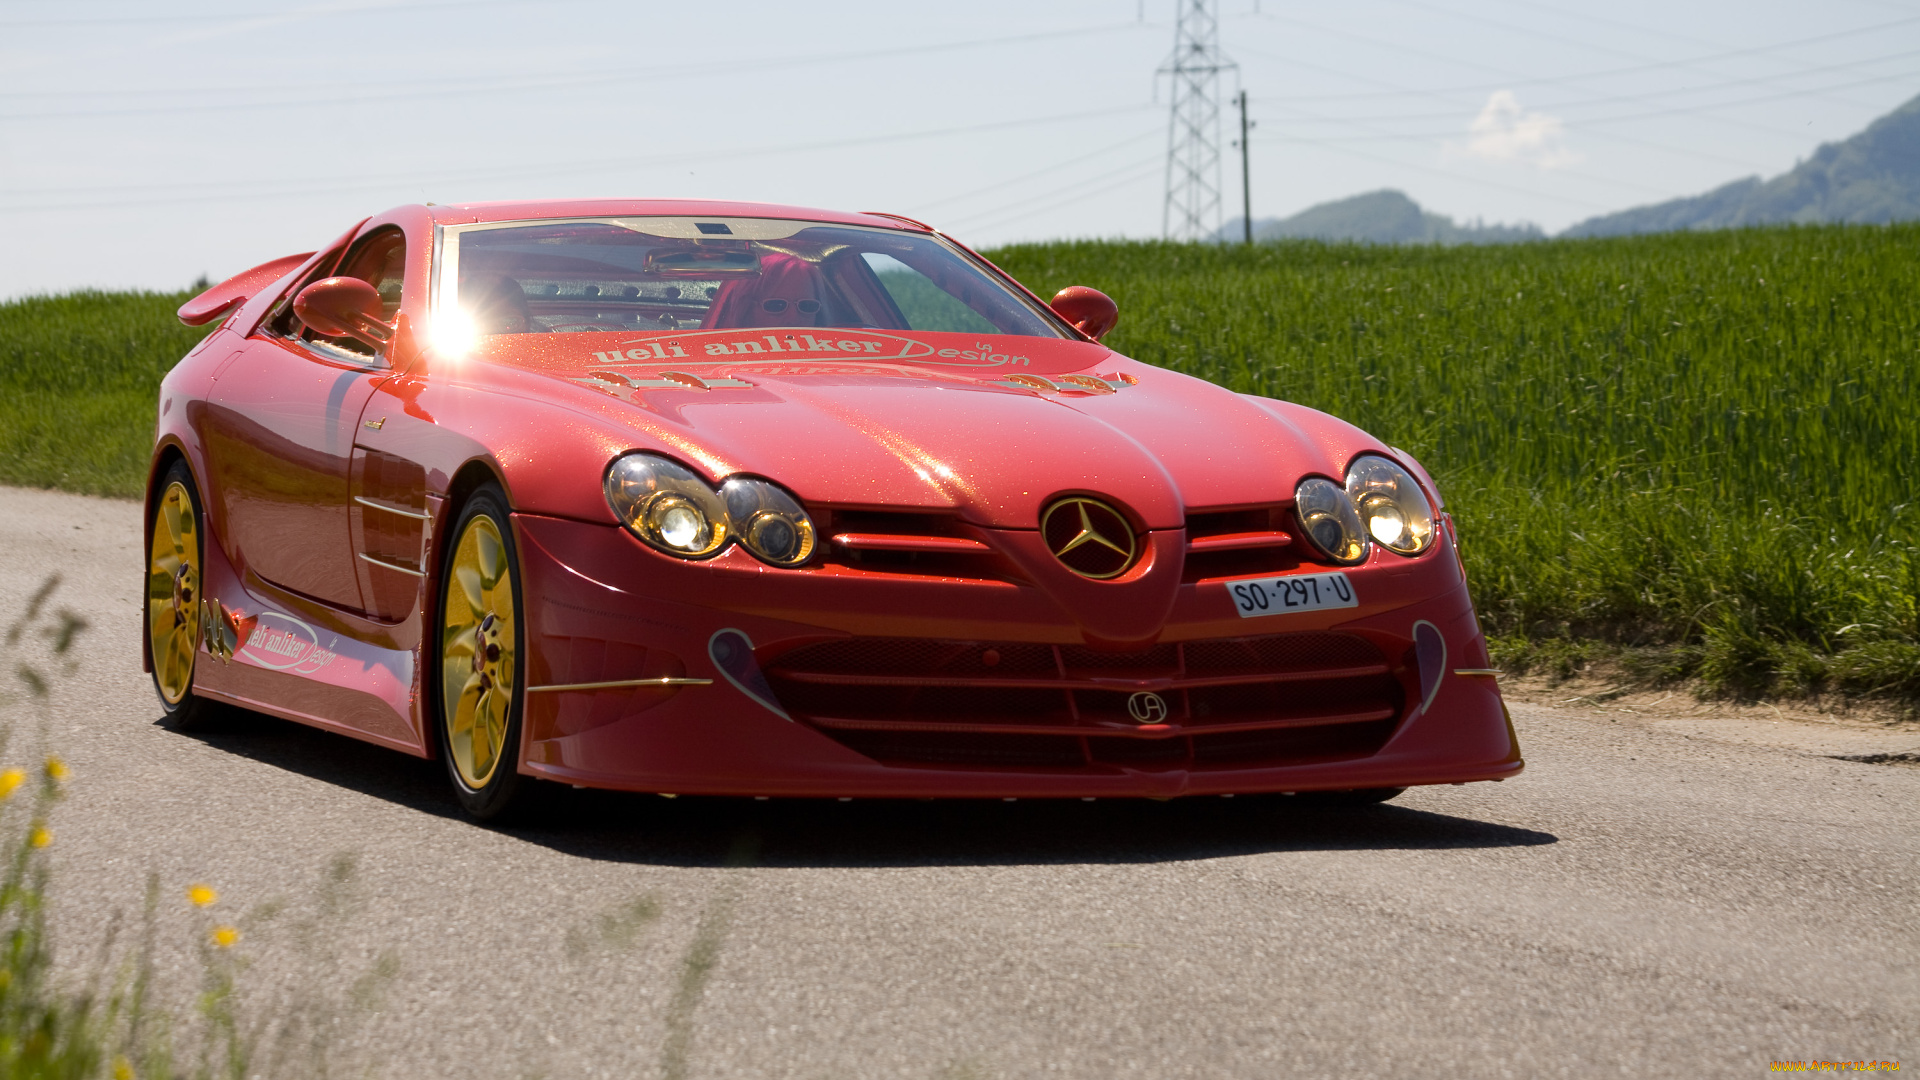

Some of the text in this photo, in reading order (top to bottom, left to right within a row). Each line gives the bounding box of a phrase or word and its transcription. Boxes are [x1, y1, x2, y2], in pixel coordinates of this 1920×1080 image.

[592, 334, 1030, 367] ueli anliker Design
[264, 631, 307, 659] anliker
